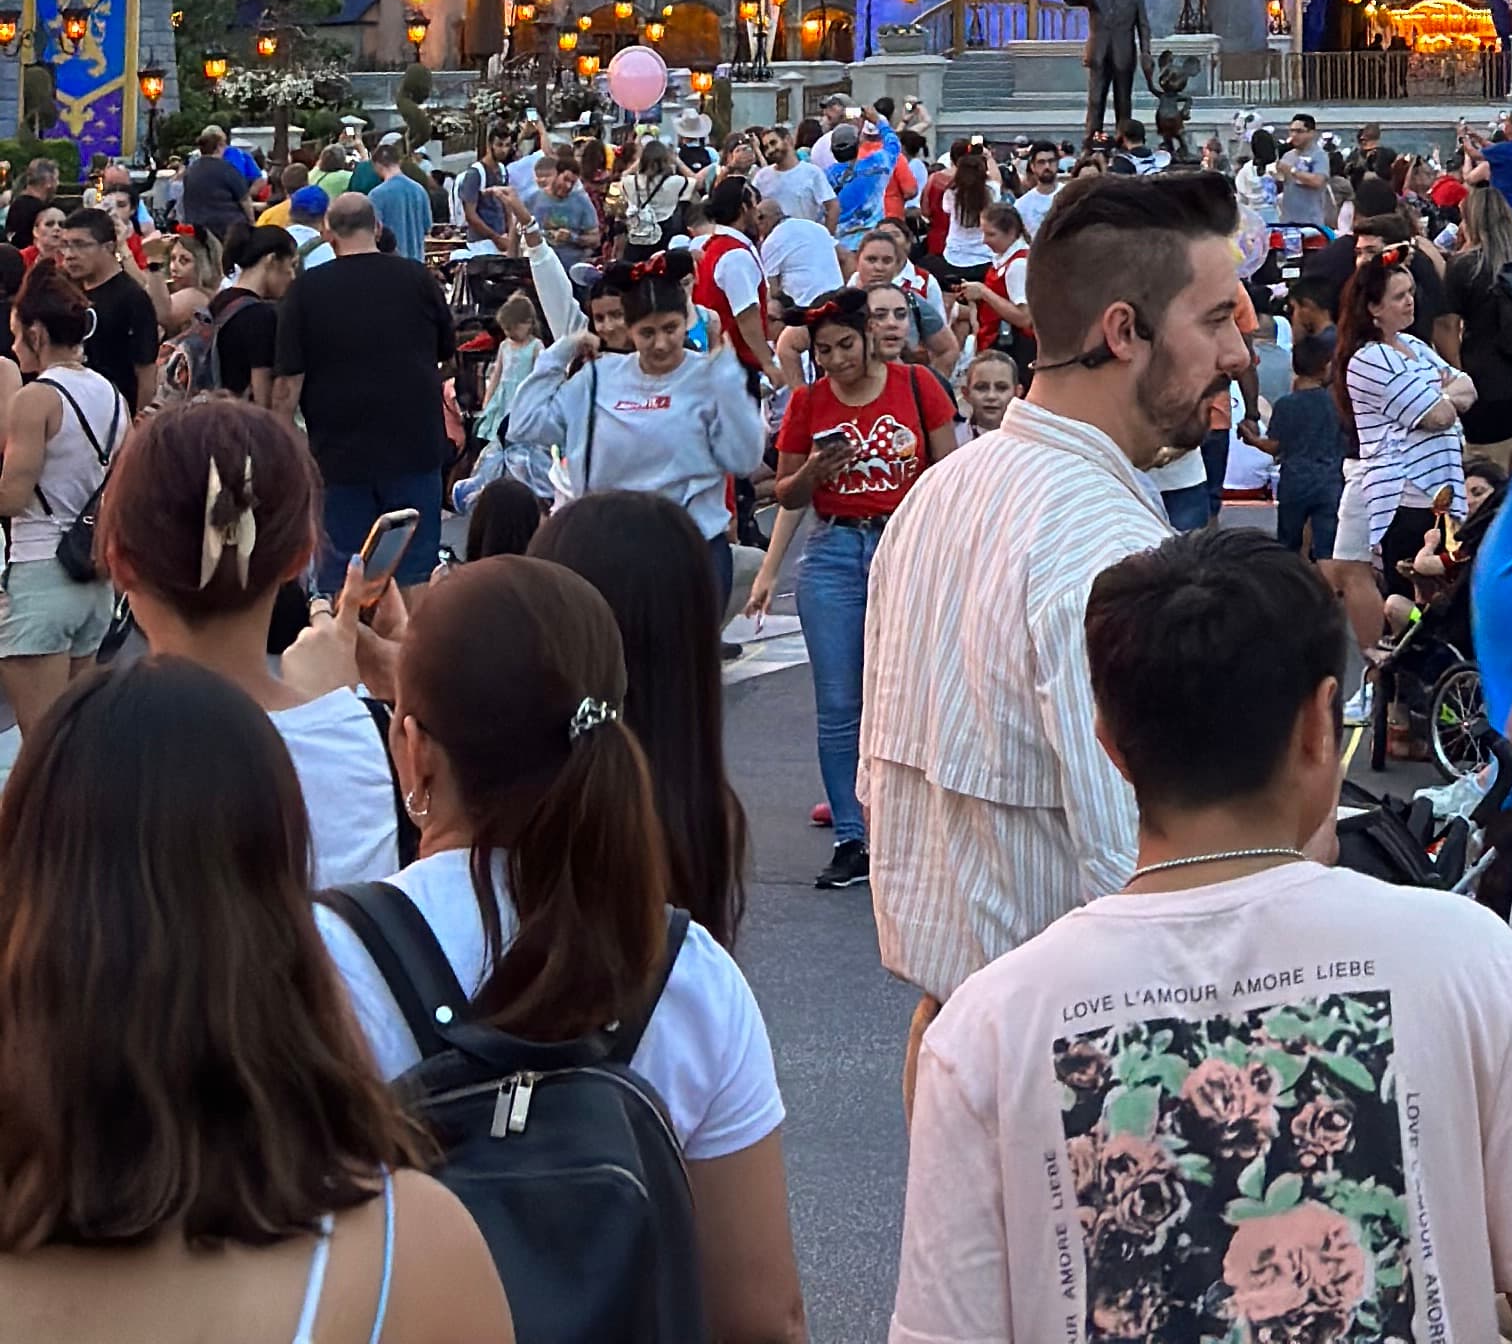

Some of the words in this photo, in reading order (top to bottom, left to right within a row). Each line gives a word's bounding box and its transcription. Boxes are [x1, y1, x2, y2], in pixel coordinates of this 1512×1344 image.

[1063, 994, 1114, 1023] LOVE
[1125, 984, 1218, 1008] L'AMOUR
[1232, 967, 1305, 997] AMORE
[1317, 959, 1376, 981] LIEBE
[1406, 1092, 1421, 1149] LOVE
[1056, 1223, 1076, 1300] AMORE
